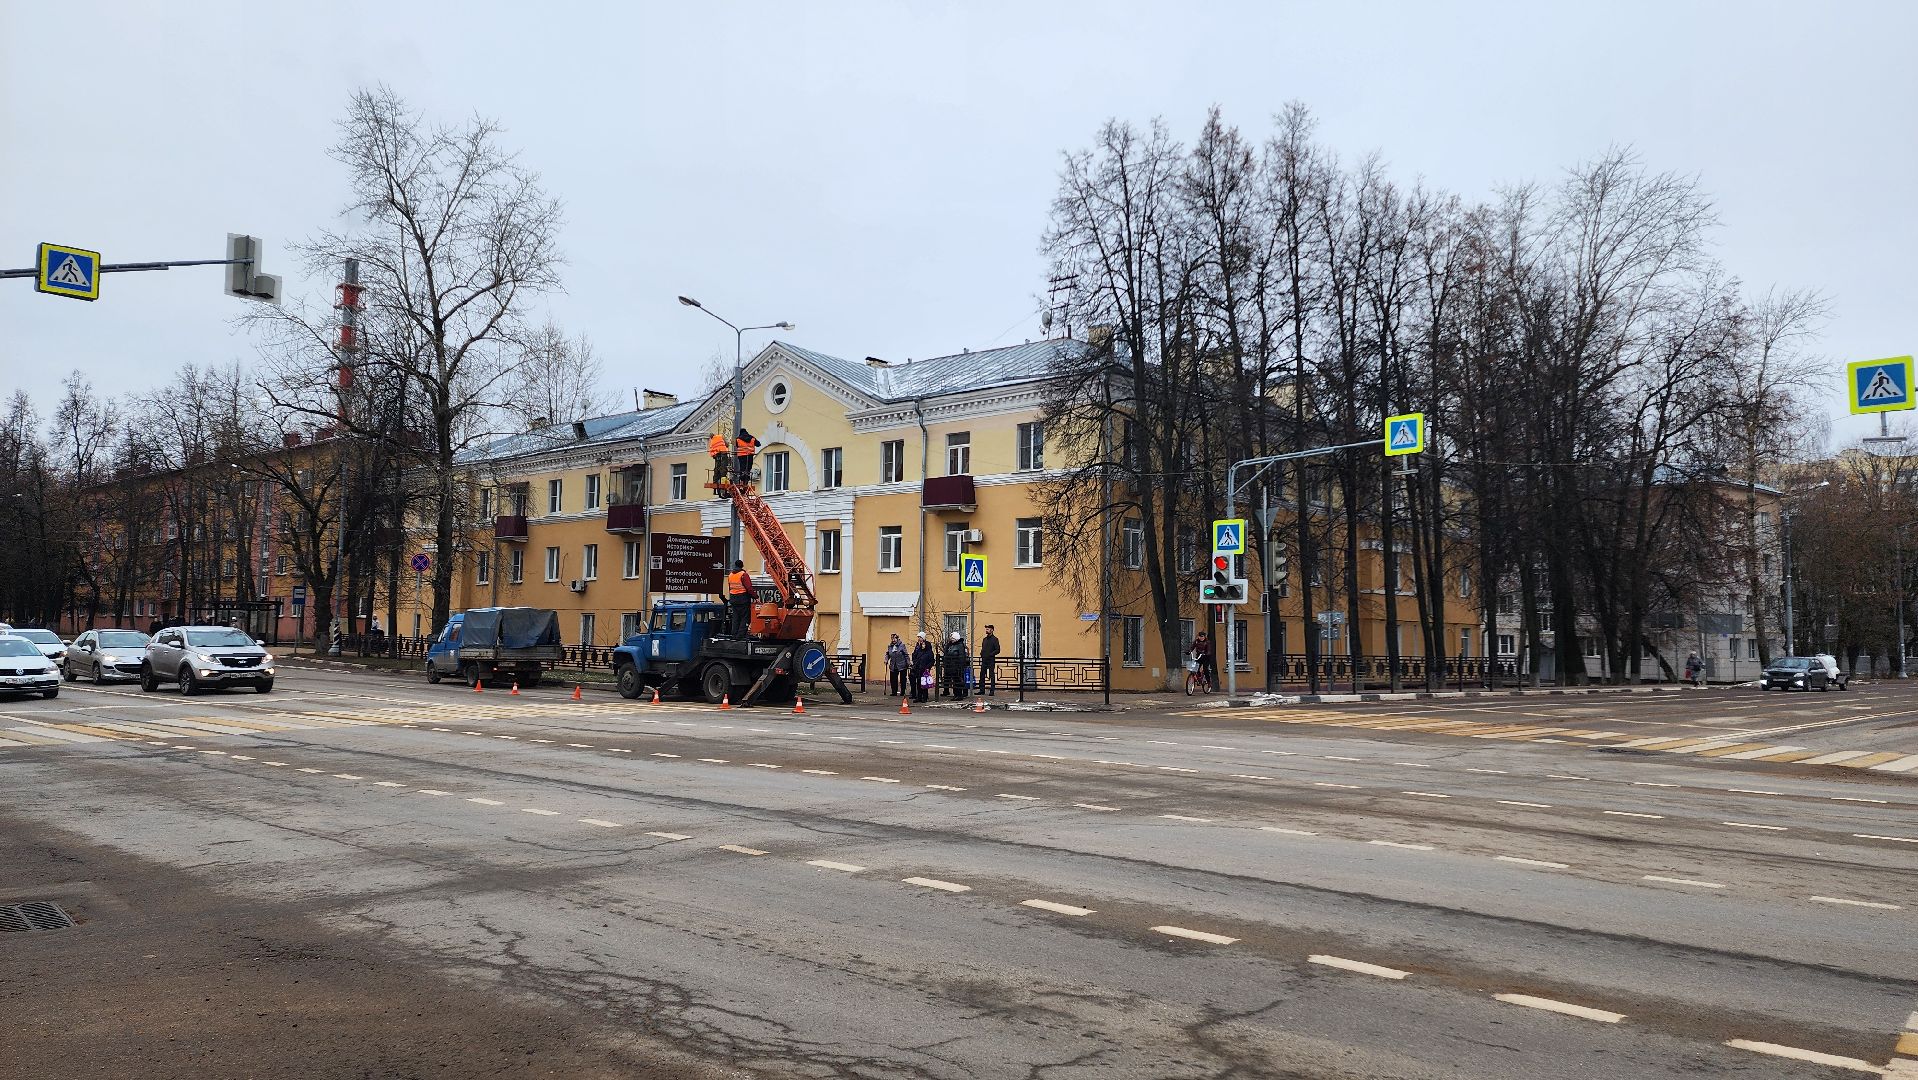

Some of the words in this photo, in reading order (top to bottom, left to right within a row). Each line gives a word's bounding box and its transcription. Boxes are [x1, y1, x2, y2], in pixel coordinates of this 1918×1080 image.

[666, 536, 710, 545] Домодедовский
[666, 550, 713, 558] художественный
[665, 569, 702, 577] Domodedovo
[665, 577, 686, 585] History
